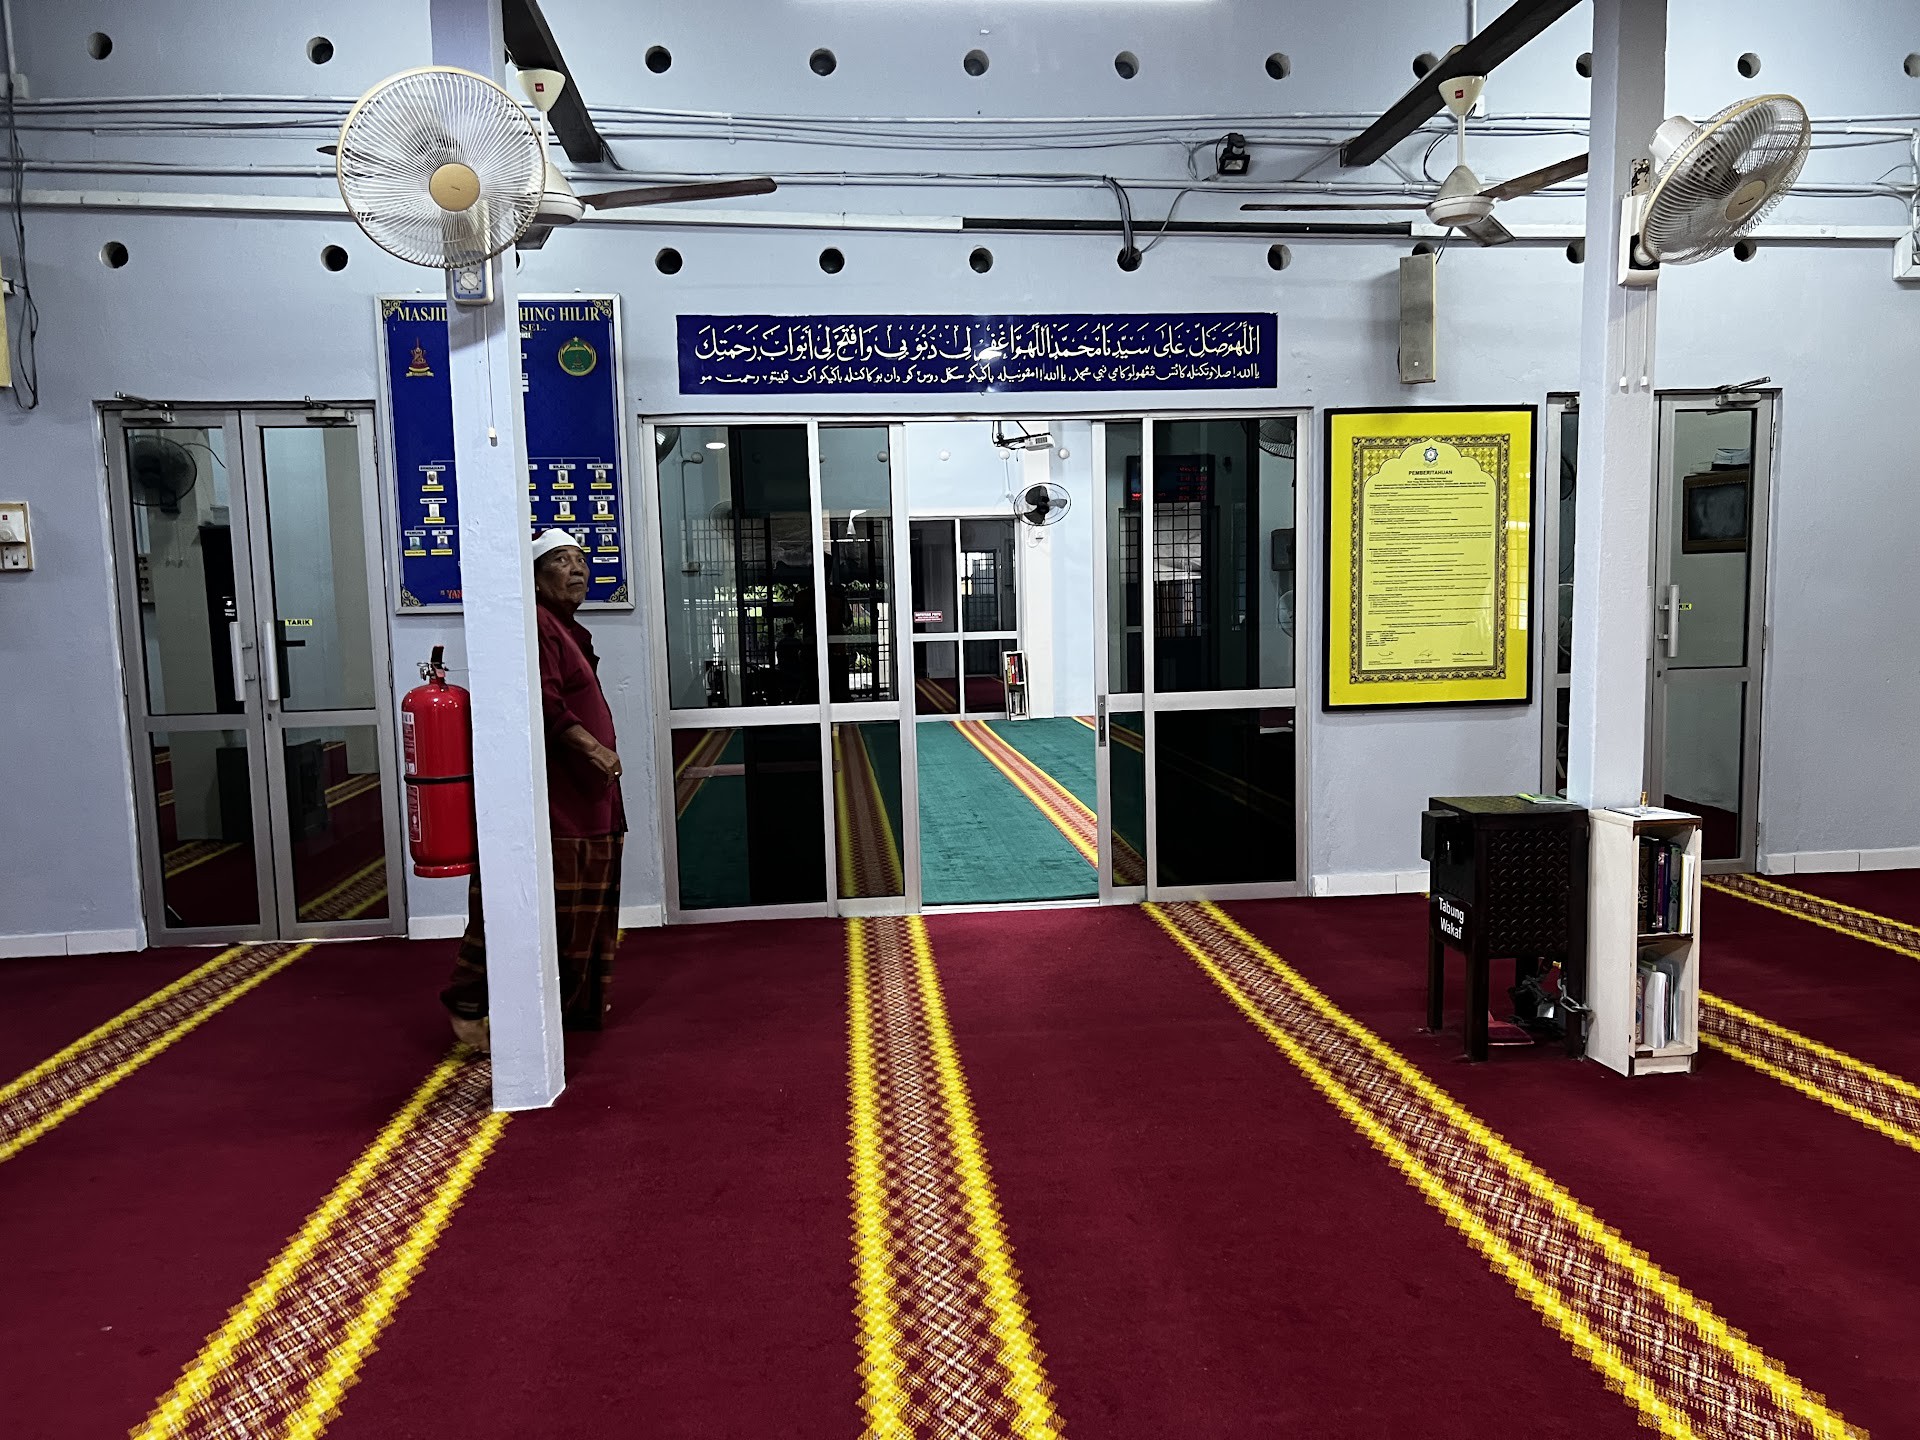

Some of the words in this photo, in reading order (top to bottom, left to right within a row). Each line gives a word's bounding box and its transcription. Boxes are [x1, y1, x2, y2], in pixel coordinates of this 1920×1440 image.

[519, 306, 556, 322] HING
[559, 306, 600, 322] HILIR
[1438, 896, 1464, 924] Tabung
[1440, 917, 1462, 940] Wakaf
